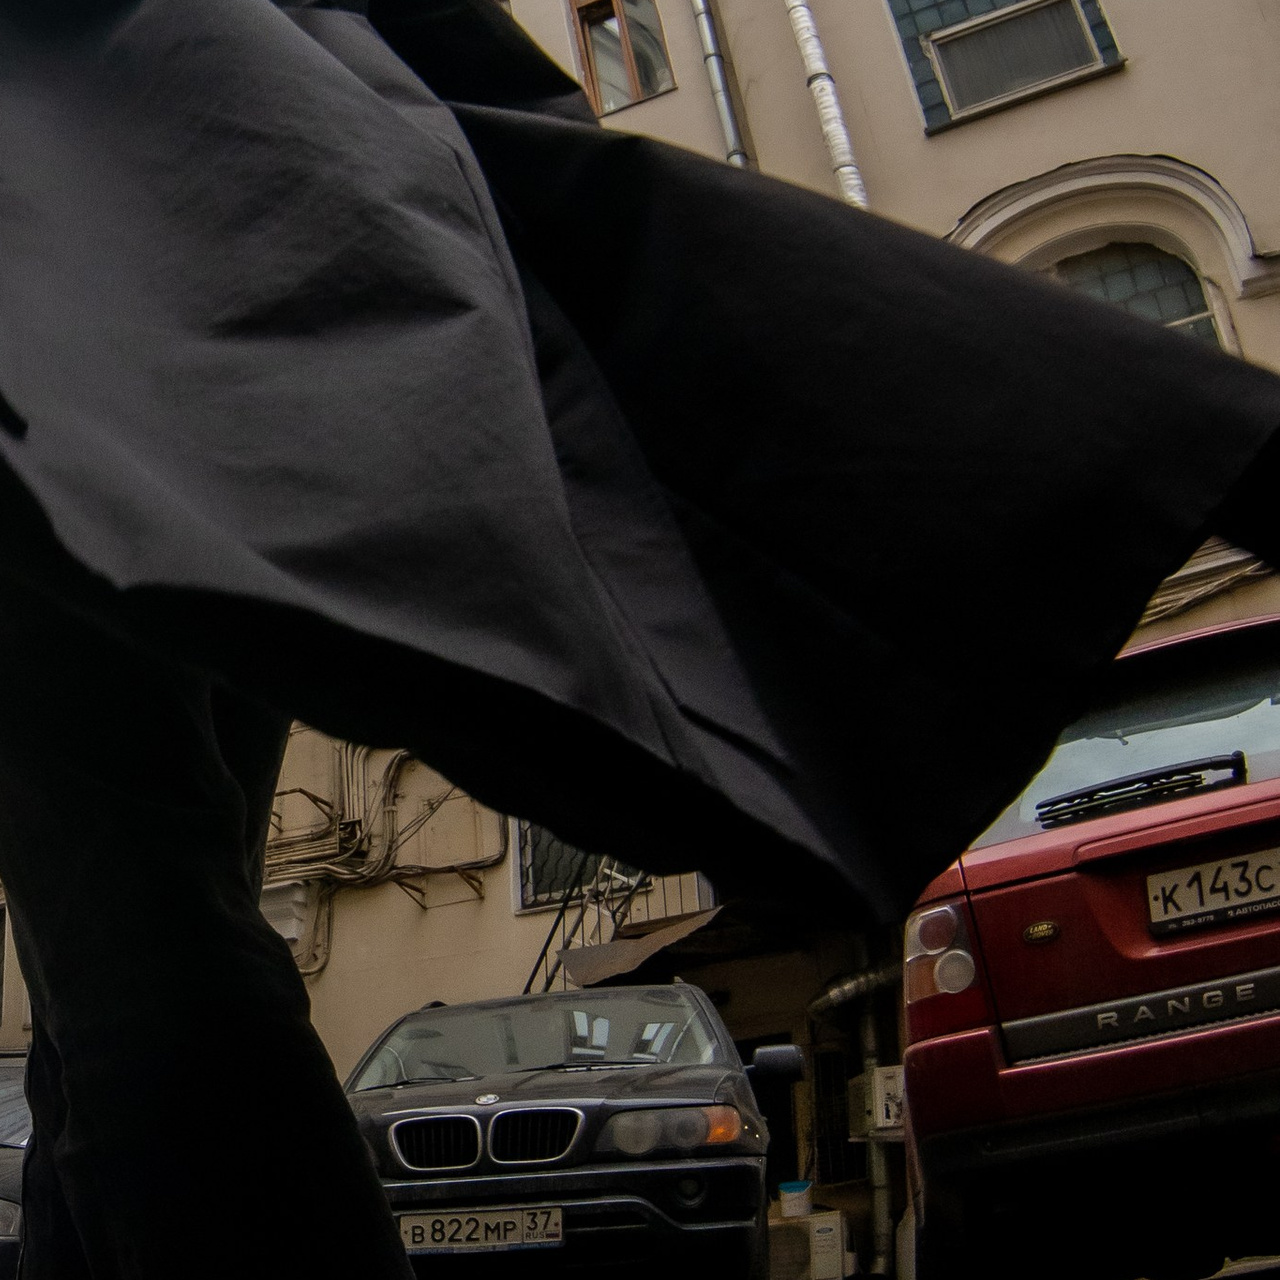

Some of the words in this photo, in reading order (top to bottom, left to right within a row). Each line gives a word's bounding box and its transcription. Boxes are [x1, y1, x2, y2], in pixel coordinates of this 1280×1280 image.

[1161, 860, 1280, 915] К143С
[1097, 983, 1255, 1030] RANGE
[525, 1232, 545, 1240] RUS
[526, 1211, 551, 1231] 37
